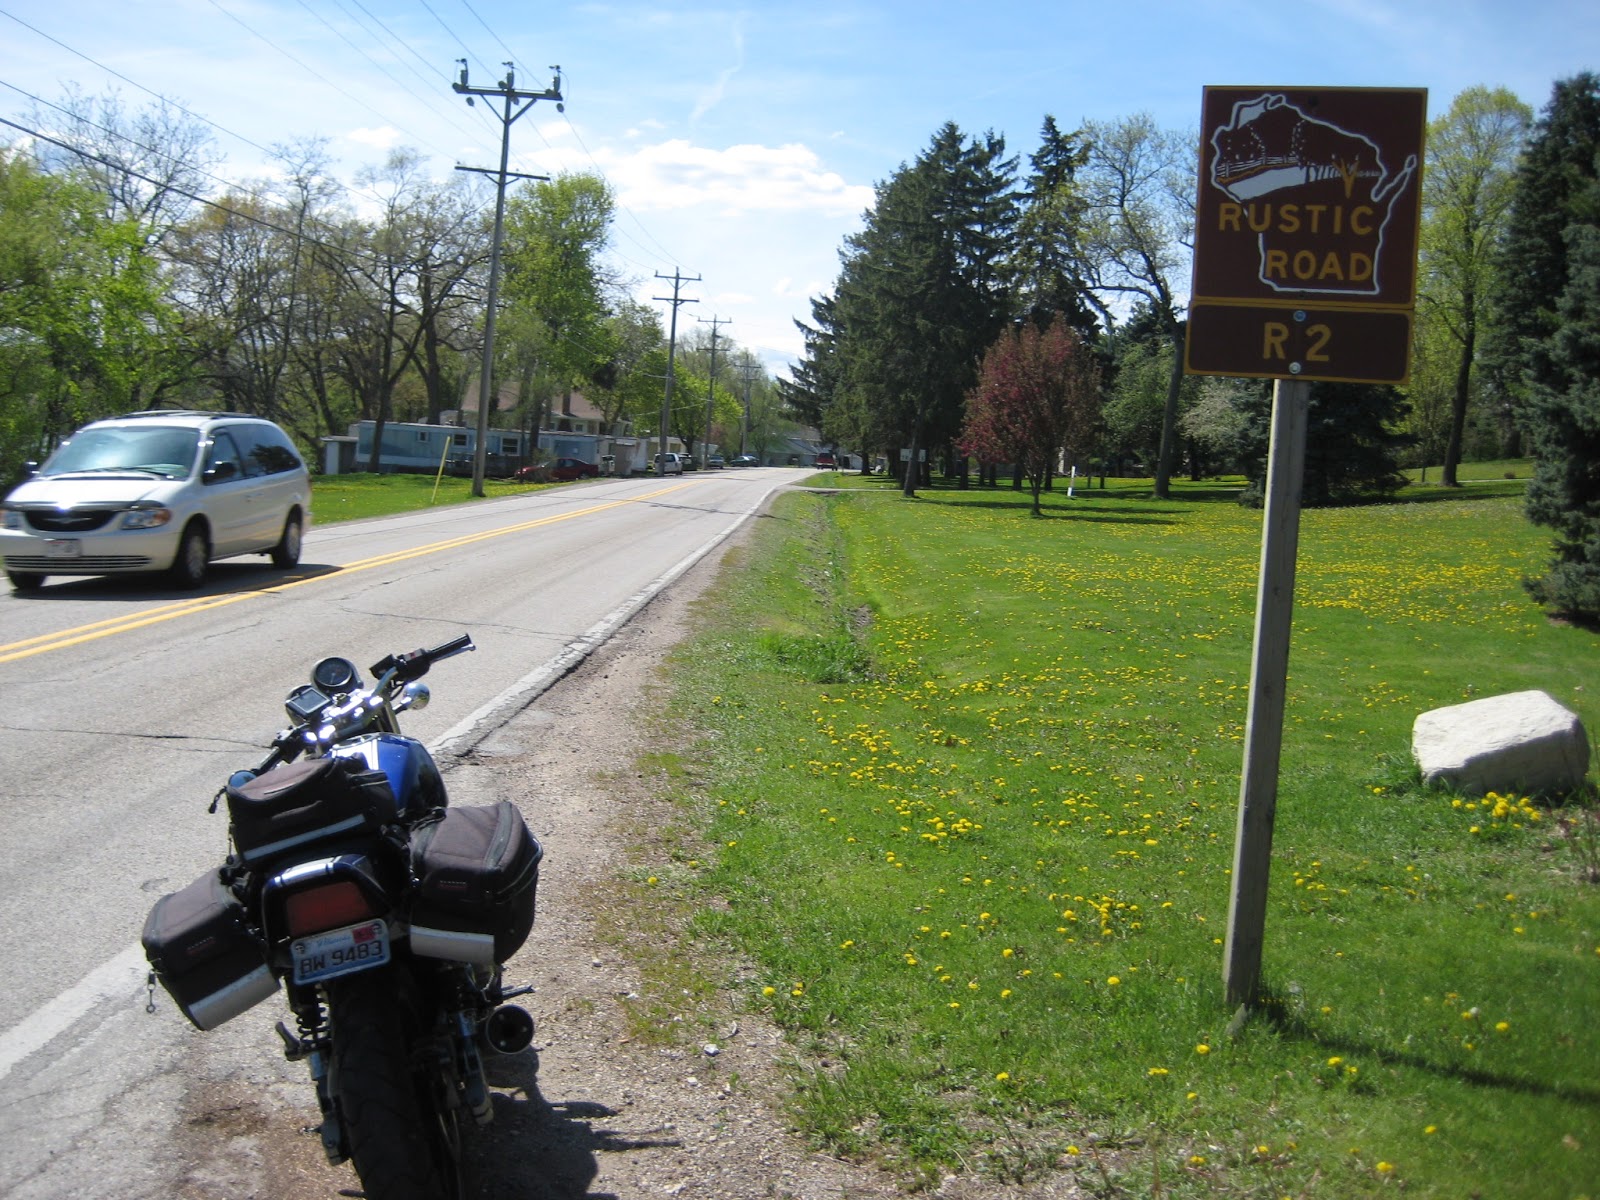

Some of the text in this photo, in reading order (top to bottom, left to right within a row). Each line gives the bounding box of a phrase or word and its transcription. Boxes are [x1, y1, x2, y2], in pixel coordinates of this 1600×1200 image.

[1218, 202, 1374, 235] RUSTIC
[1265, 249, 1373, 281] ROAD
[1262, 322, 1332, 362] R 2
[300, 940, 383, 975] BW 9483
